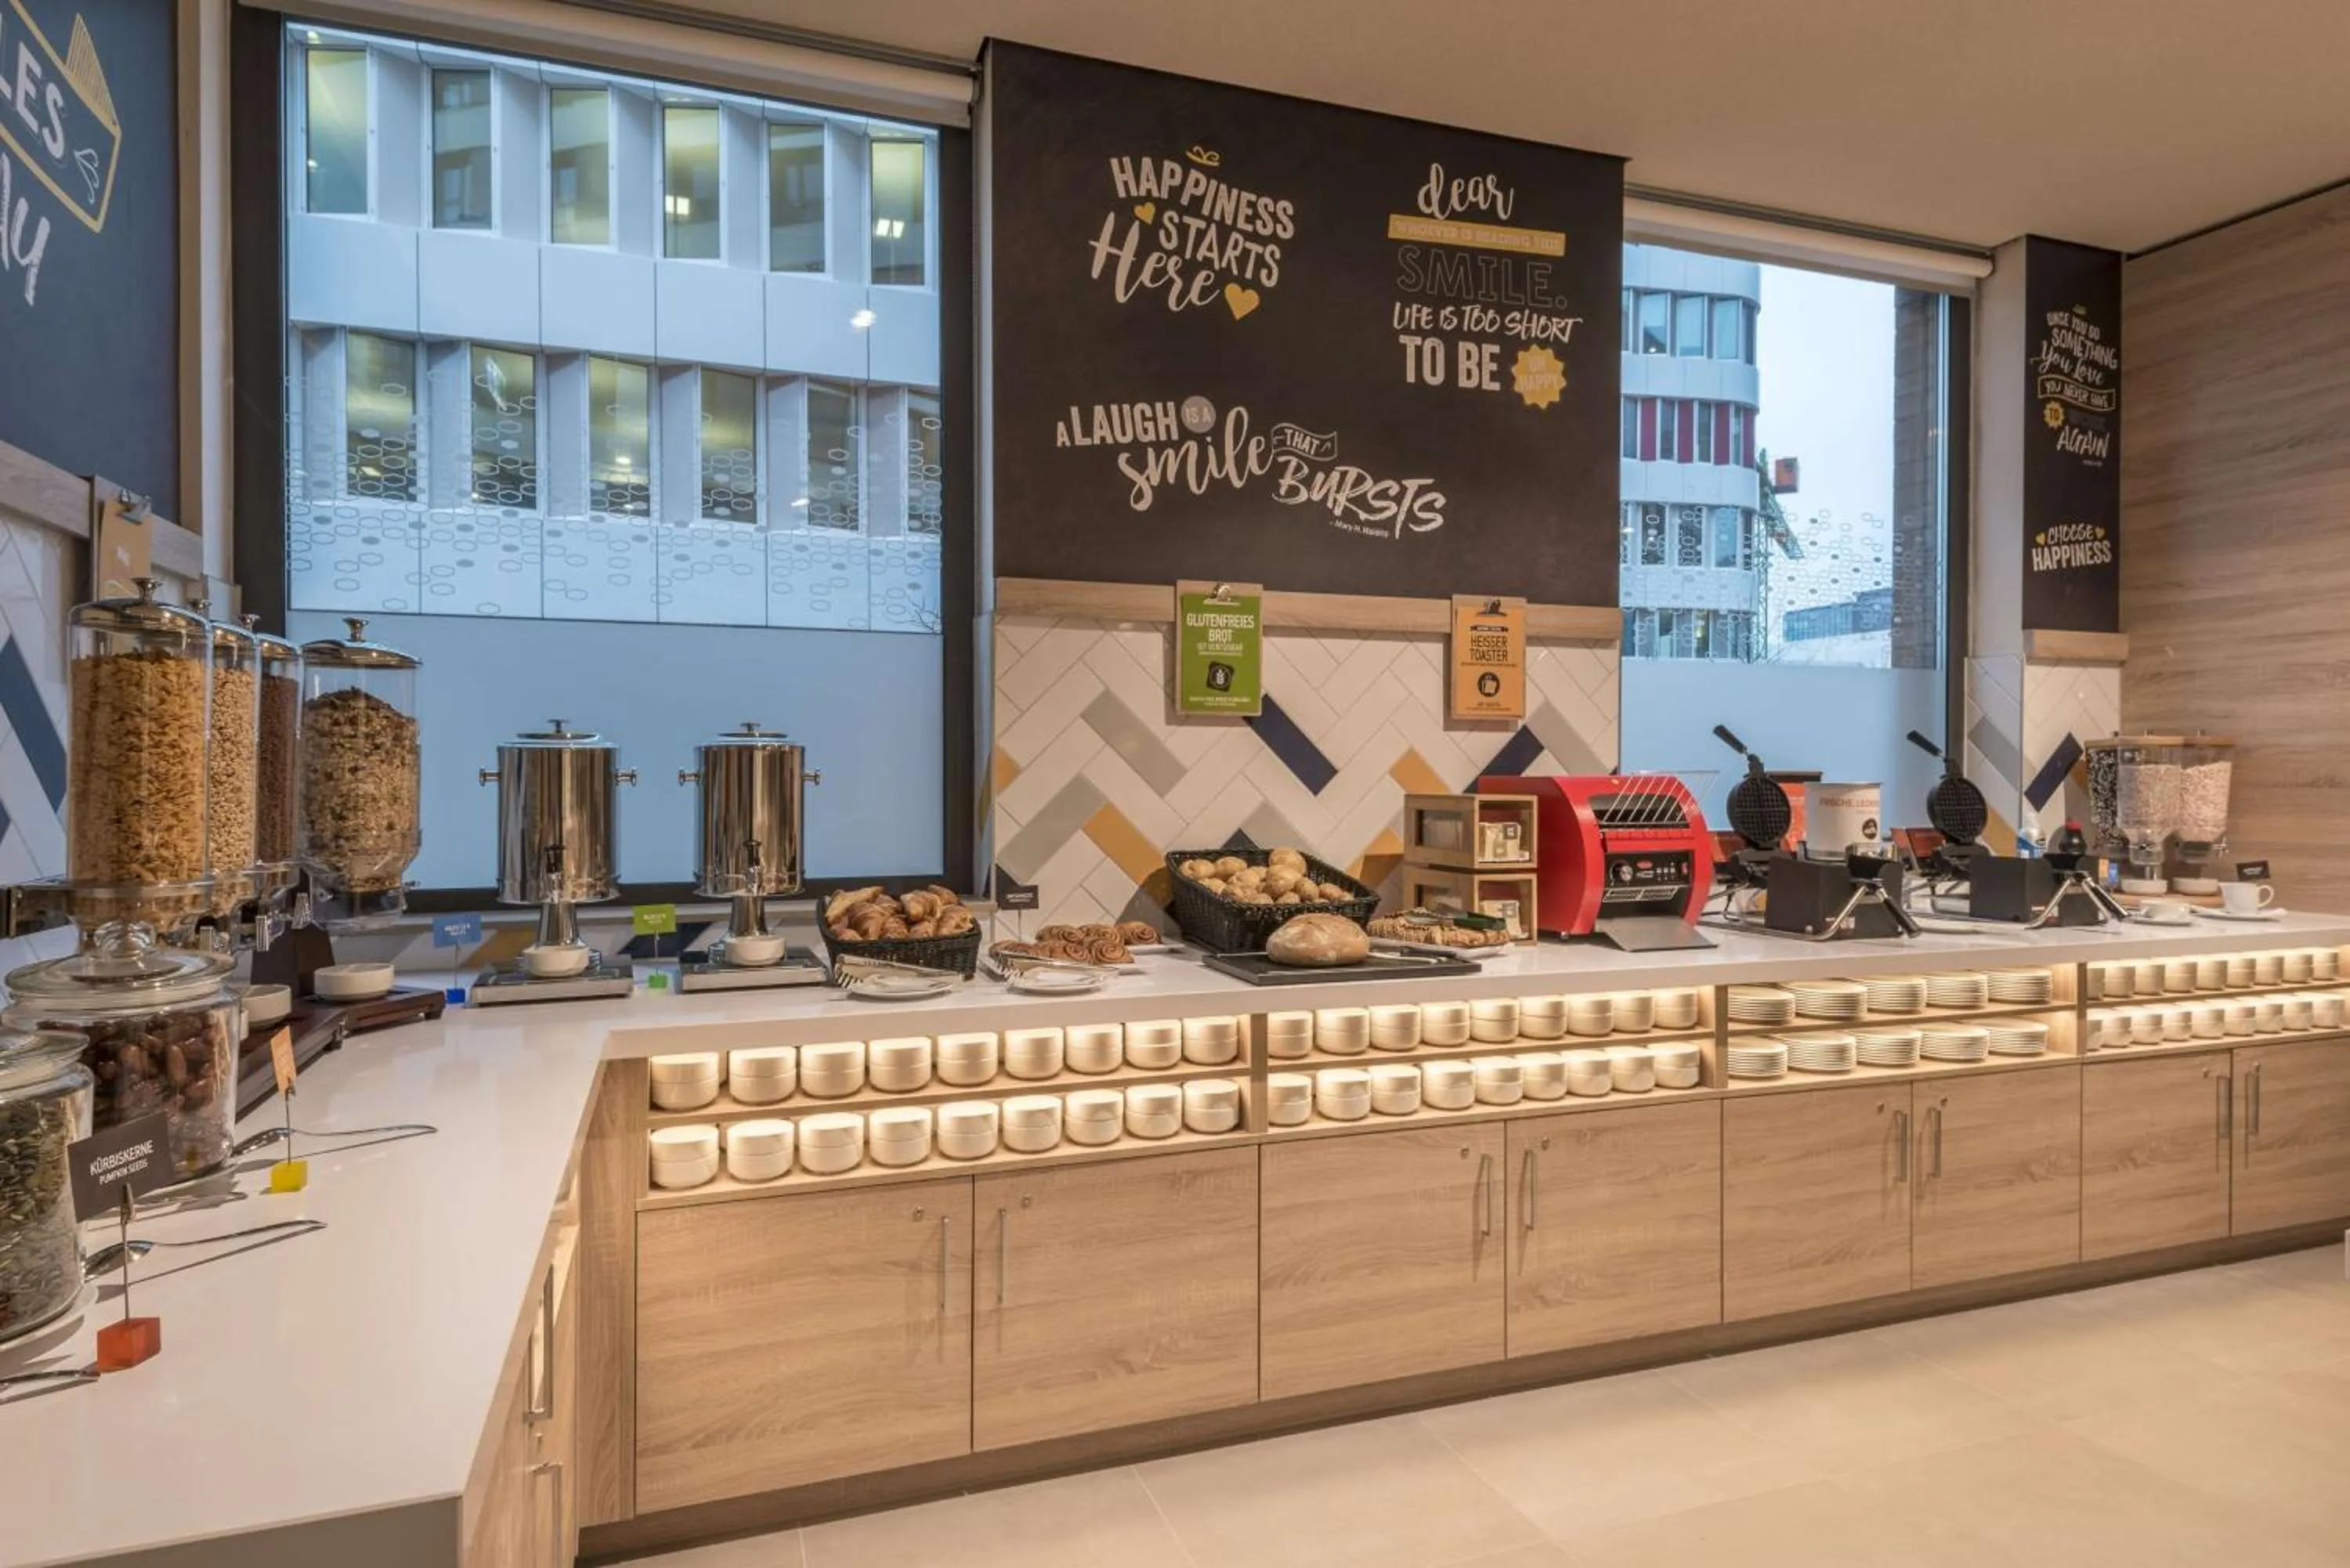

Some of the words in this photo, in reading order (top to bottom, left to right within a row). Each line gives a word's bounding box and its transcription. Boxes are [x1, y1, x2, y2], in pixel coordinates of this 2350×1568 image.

[1110, 156, 1294, 240] HAPPINESS
[1417, 162, 1514, 220] dear
[1088, 211, 1220, 312] Here
[1159, 210, 1282, 287] STARTS
[1392, 301, 1434, 331] LIFE
[1439, 306, 1458, 331] IS
[1462, 304, 1500, 333] TOO
[1504, 309, 1584, 343] SHORT
[1398, 334, 1445, 386] TO
[1457, 340, 1501, 391] BE
[2038, 340, 2073, 374] You
[2052, 327, 2118, 370] SOMETHING
[1056, 421, 1071, 447] A
[1070, 402, 1178, 446] LAUGH
[1185, 406, 1199, 424] IS
[1202, 406, 1211, 423] A
[2048, 408, 2059, 421] TO
[1284, 428, 1320, 455] THAT
[2056, 425, 2110, 458] AGAIN
[1118, 406, 1274, 511] smile
[2047, 522, 2094, 545] CHOOSE
[2032, 540, 2113, 573] HAPPINESS
[1186, 613, 1255, 629] GLUTENFREIES
[1209, 629, 1234, 642] BROT
[1469, 649, 1509, 662] TOASTER
[1470, 635, 1509, 649] HEISSER
[99, 1166, 128, 1185] PUMPKIN
[128, 1158, 149, 1175] SEEDS
